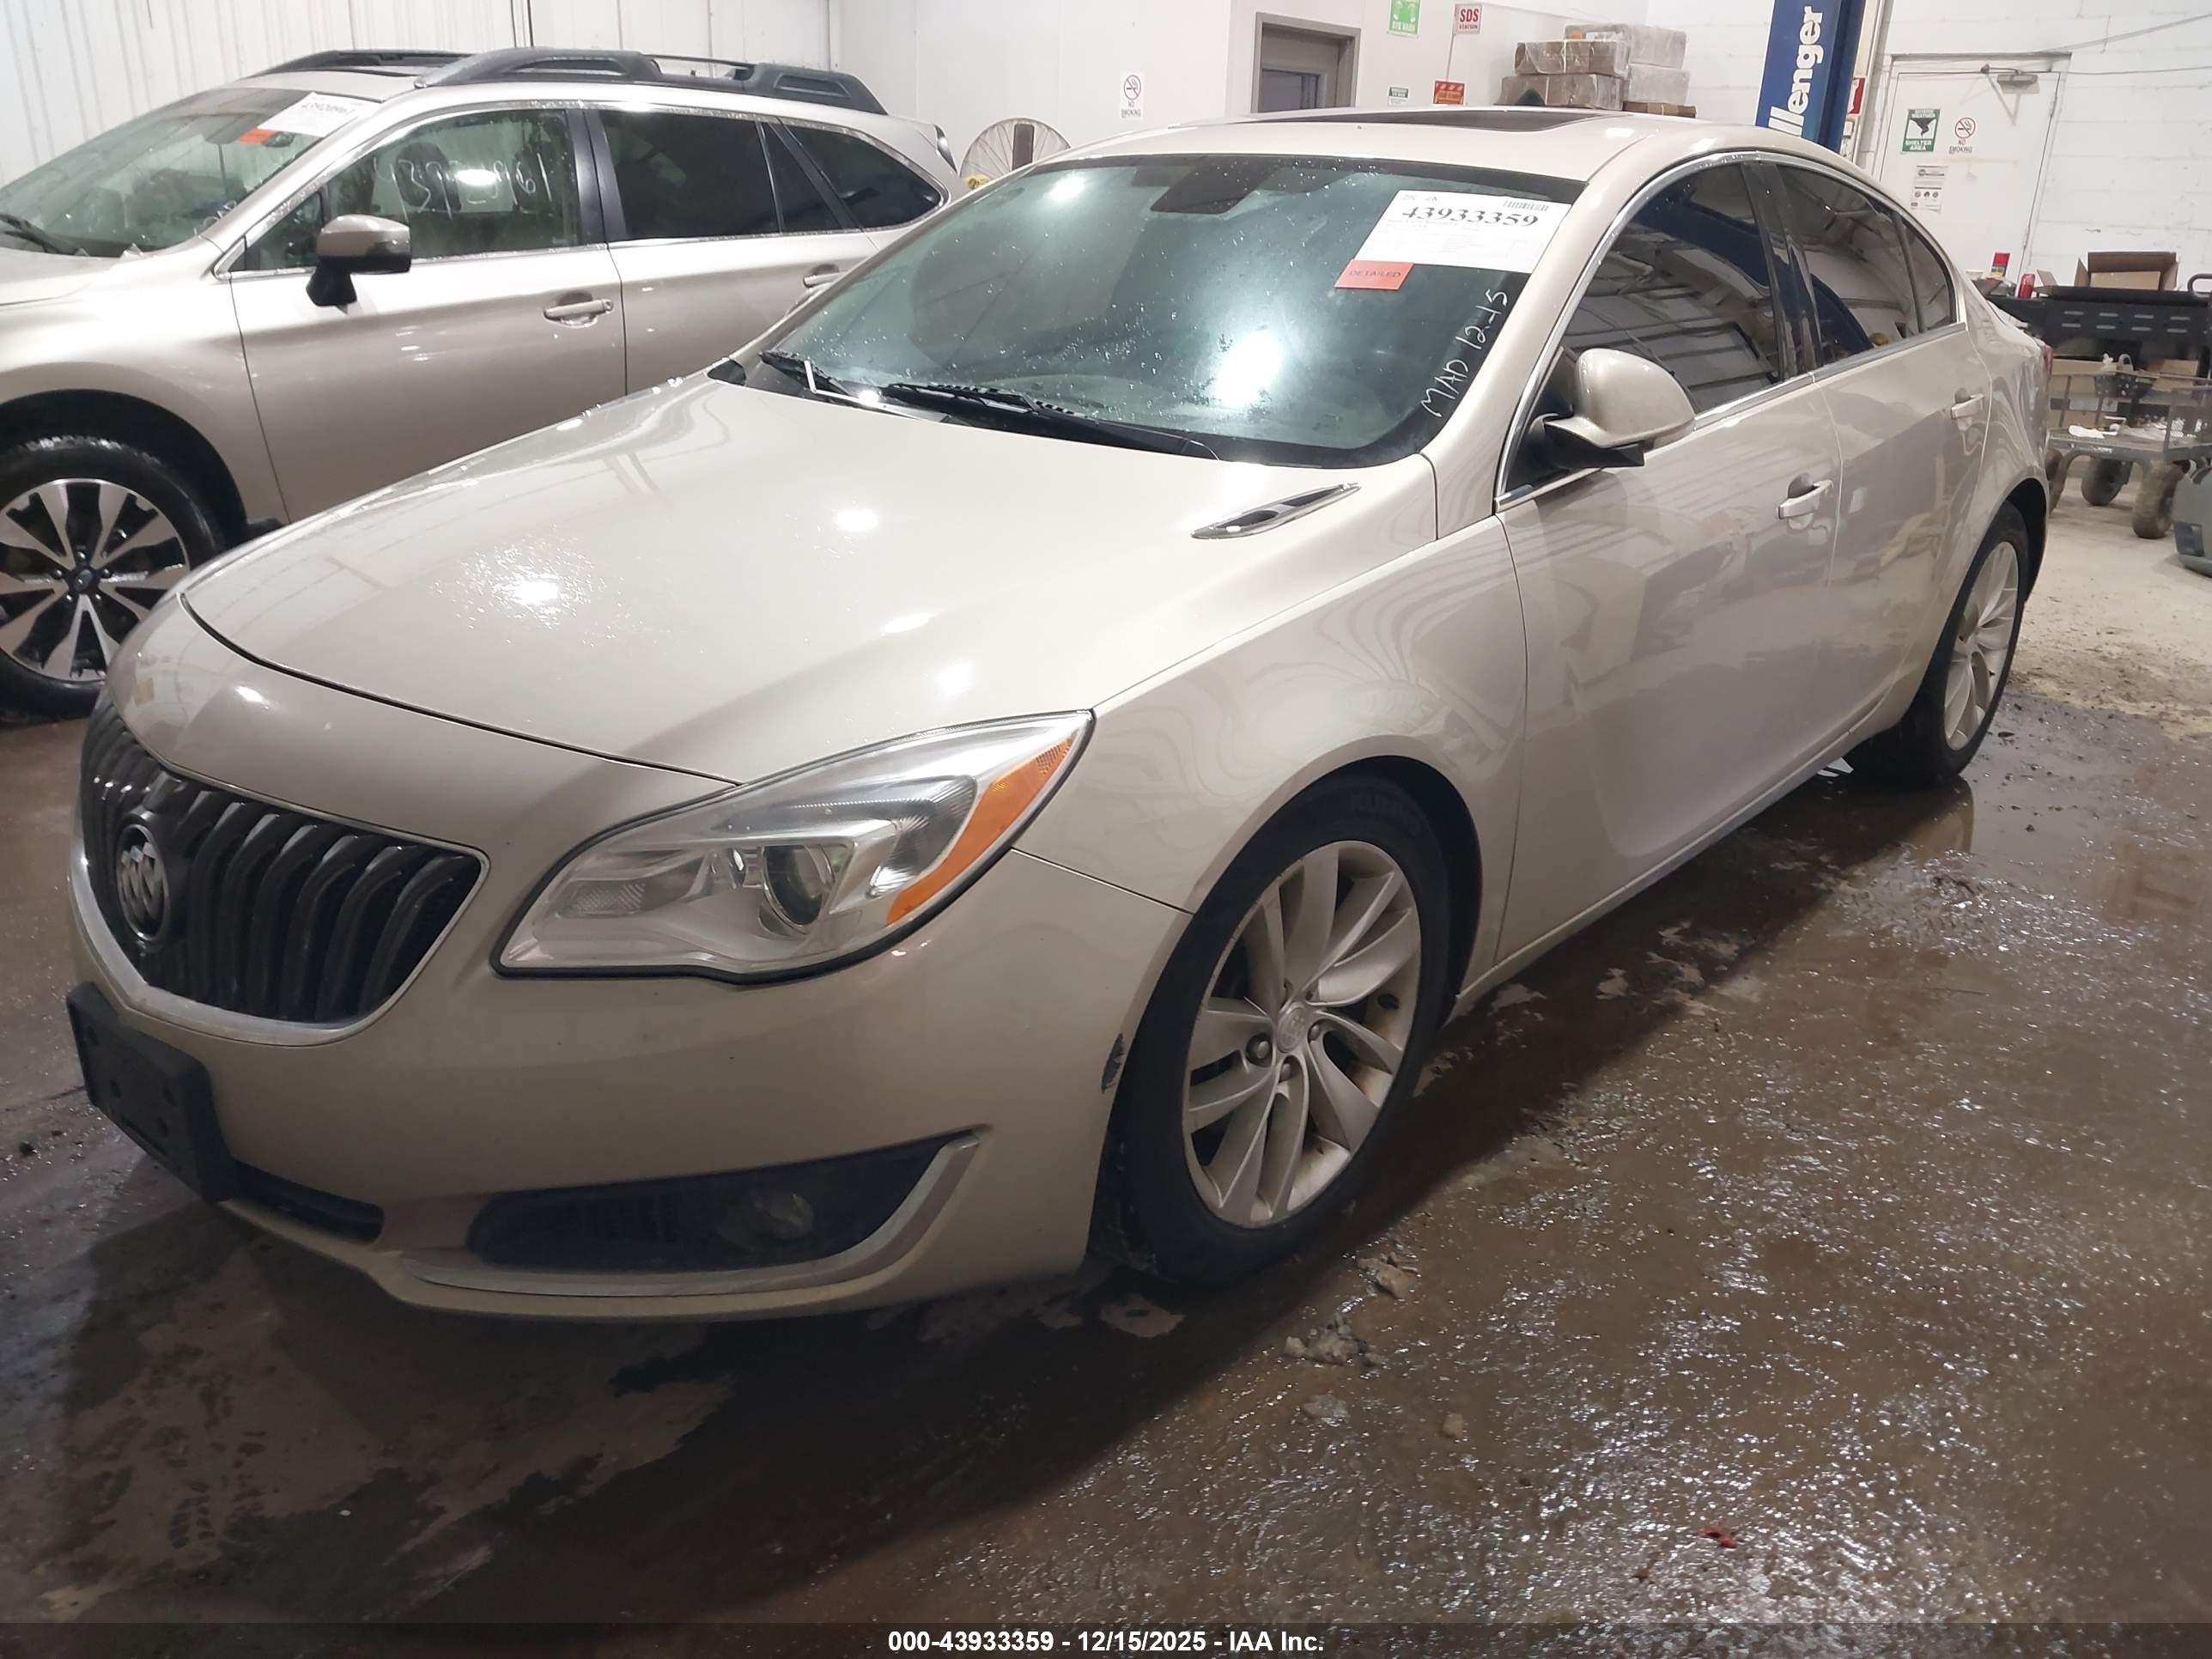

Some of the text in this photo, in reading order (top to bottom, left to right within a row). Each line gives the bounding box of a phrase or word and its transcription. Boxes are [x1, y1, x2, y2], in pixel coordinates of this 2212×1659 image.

[1460, 9, 1479, 22] SDS
[1768, 5, 1824, 137] llenger
[1121, 109, 1141, 118] SMOKING
[1401, 206, 1539, 227] 43933359
[1349, 270, 1401, 278] DETAILED
[1420, 289, 1508, 417] MAD 12-15
